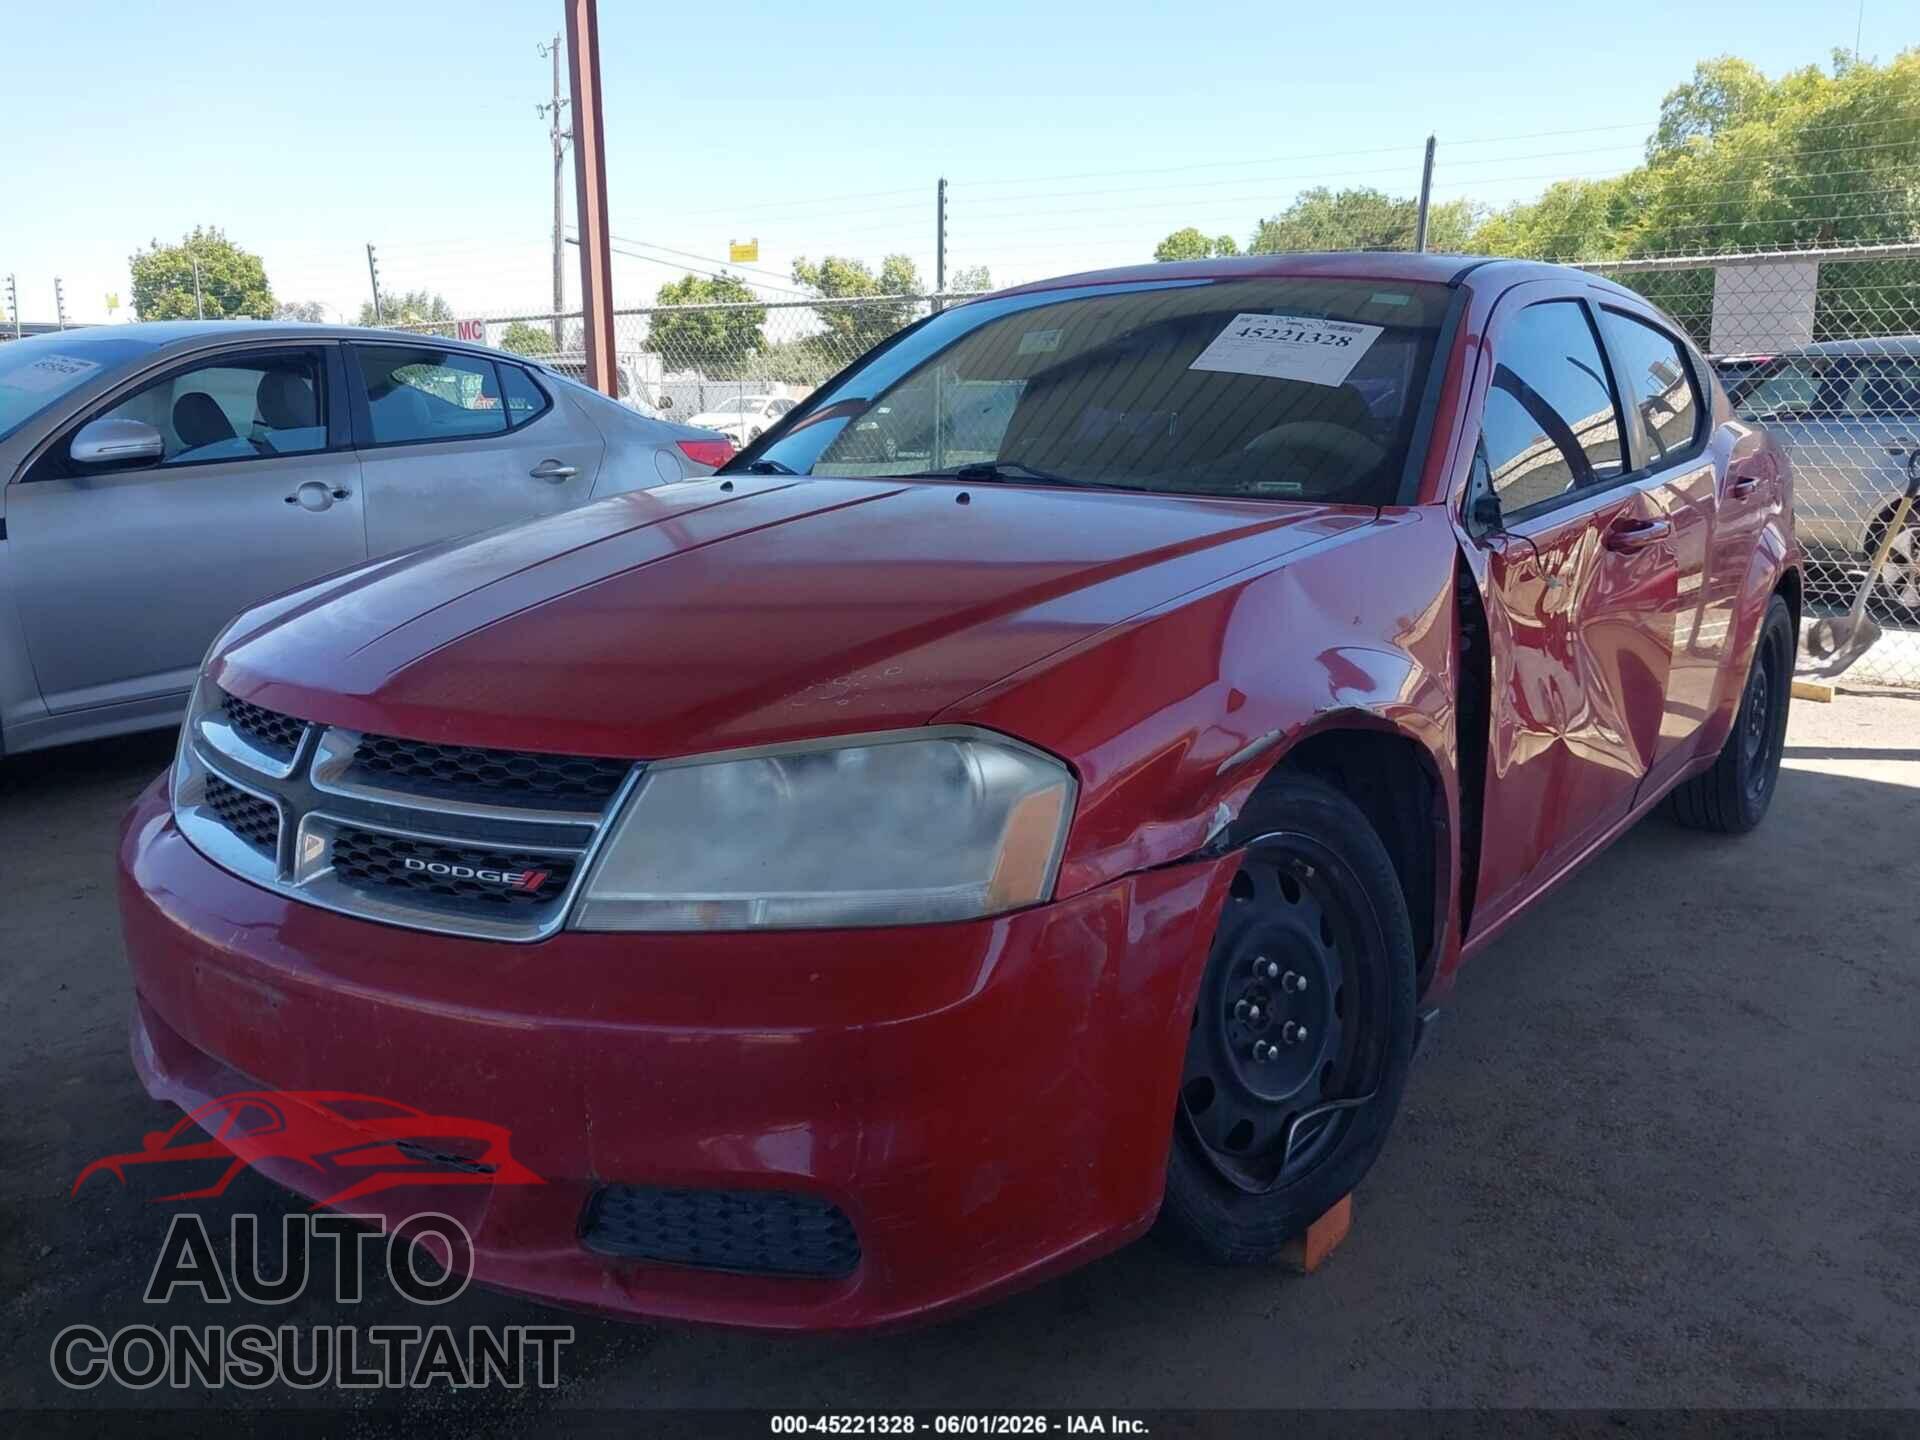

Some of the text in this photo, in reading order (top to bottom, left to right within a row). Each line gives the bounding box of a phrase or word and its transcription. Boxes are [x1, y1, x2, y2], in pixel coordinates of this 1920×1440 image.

[457, 320, 482, 341] MC
[1235, 326, 1353, 348] 45221328
[403, 857, 526, 886] DODGE
